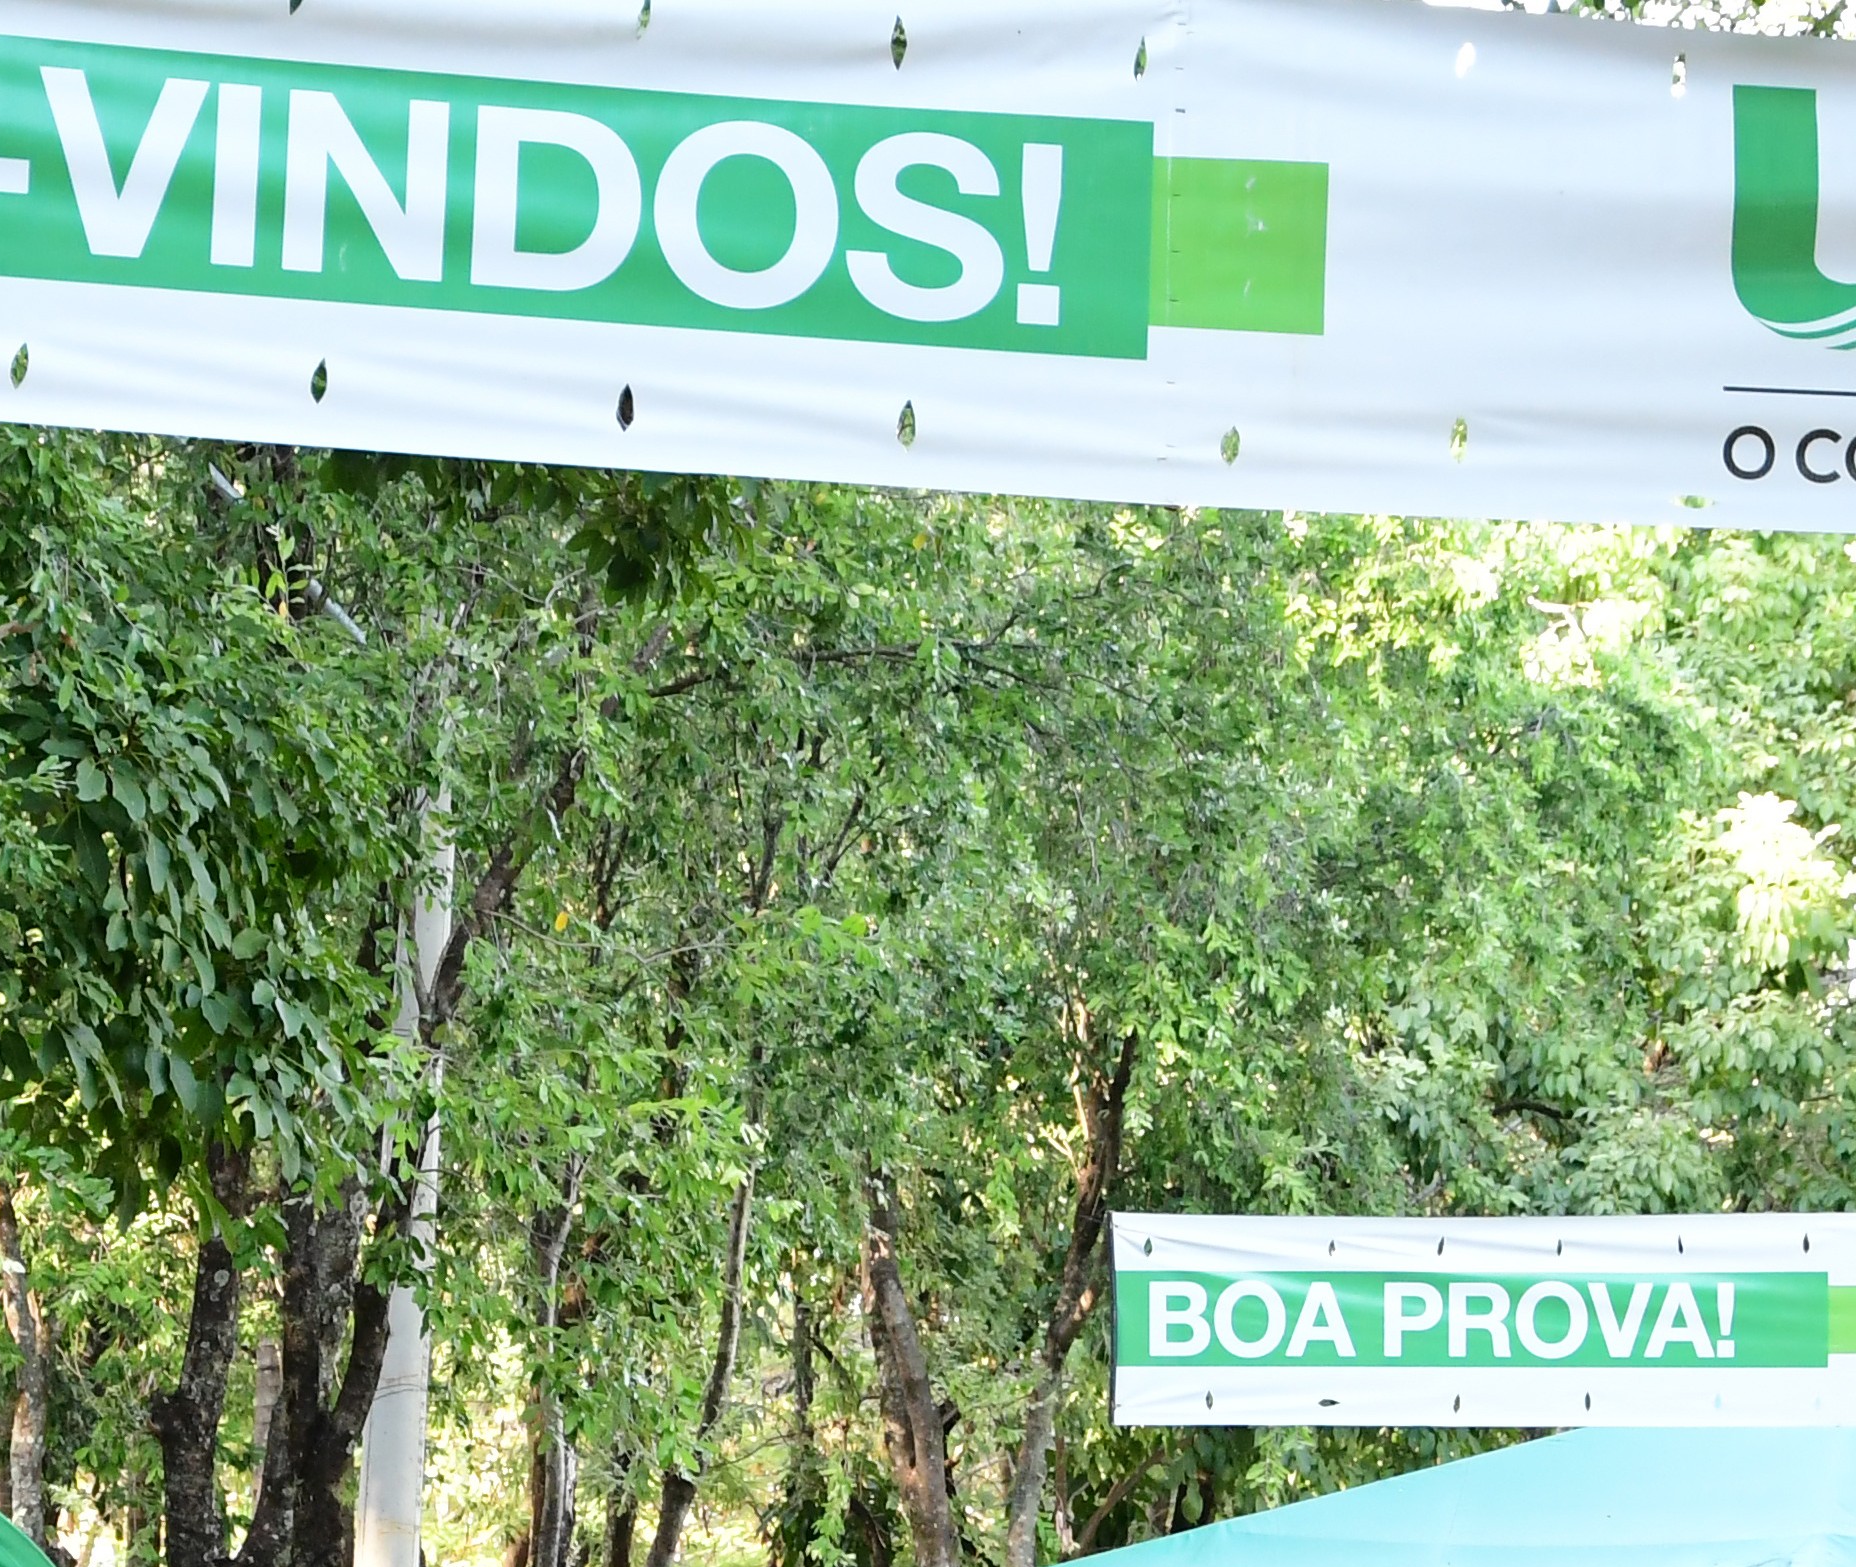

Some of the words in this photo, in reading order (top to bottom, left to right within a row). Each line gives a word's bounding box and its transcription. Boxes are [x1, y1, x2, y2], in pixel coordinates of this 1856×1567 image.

[1722, 425, 1775, 481] O
[1149, 1280, 1356, 1358] BOA
[1383, 1280, 1736, 1359] PROVA!
